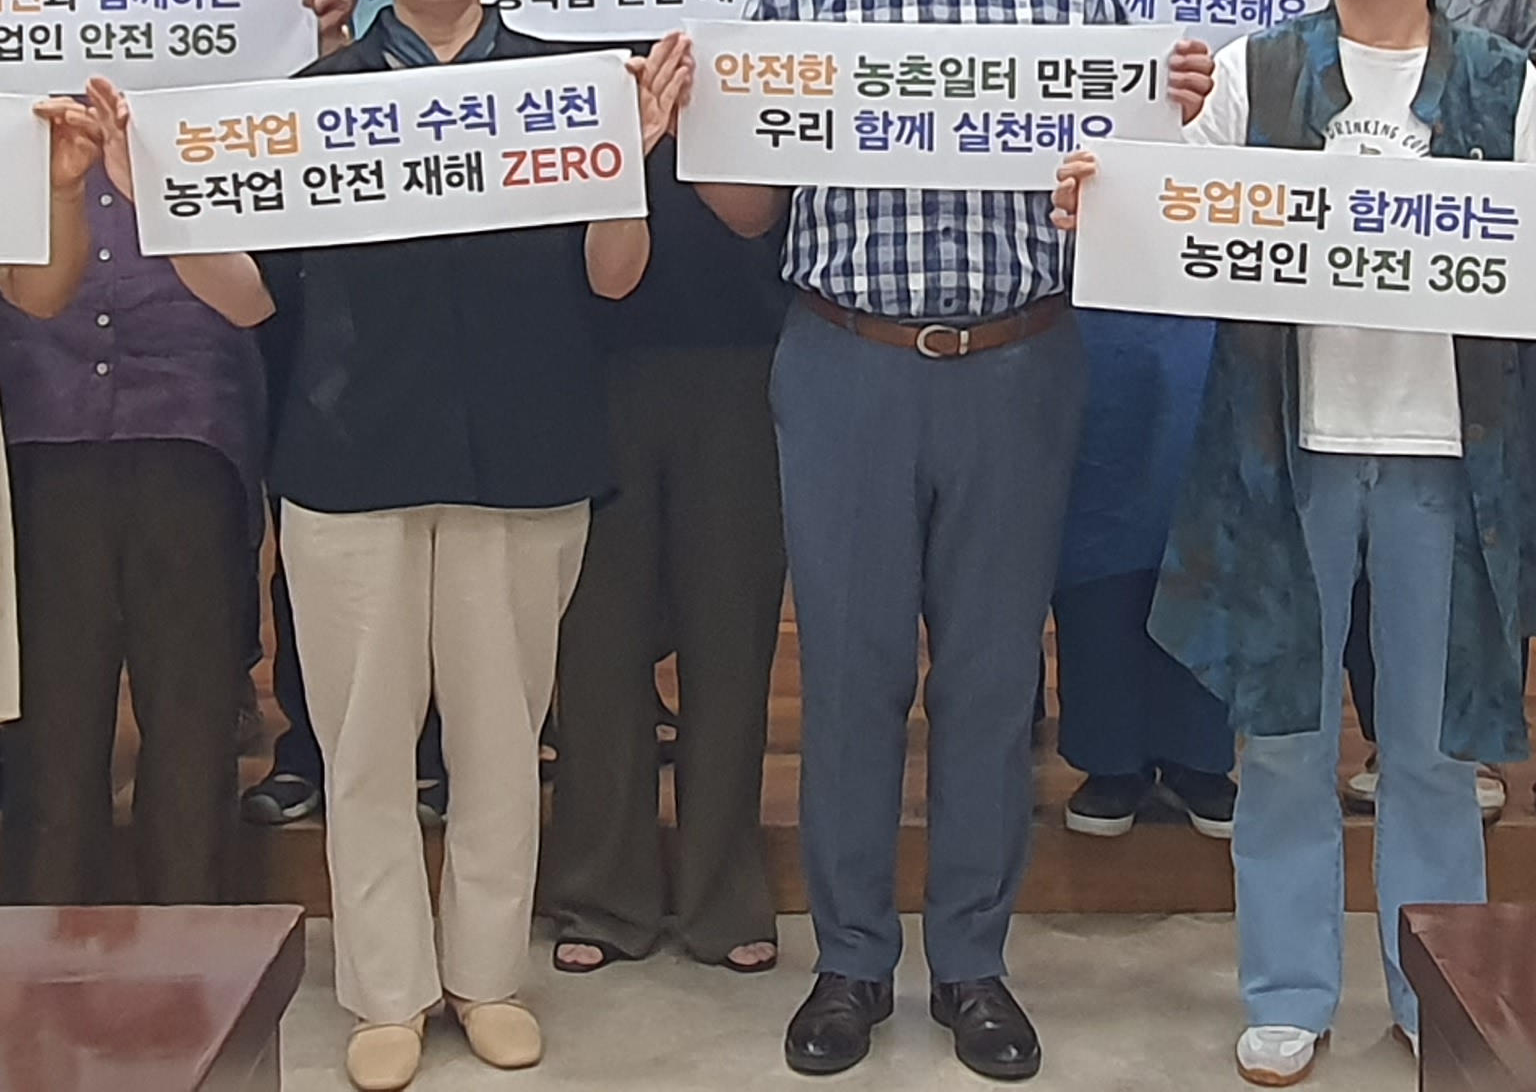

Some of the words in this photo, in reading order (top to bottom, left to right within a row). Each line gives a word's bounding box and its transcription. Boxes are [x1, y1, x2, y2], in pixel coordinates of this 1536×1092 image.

[80, 22, 154, 59] 안전
[168, 23, 237, 56] 365
[714, 53, 838, 97] 안전한
[853, 55, 1017, 100] 농촌일터
[1037, 58, 1158, 101] 만들기
[175, 112, 300, 163] 농작업
[316, 103, 401, 150] 안전
[416, 94, 497, 142] 수칙
[515, 84, 600, 132] 실천
[755, 108, 835, 150] 우리
[853, 110, 936, 152] 함께
[164, 168, 284, 217] 농작업
[302, 159, 386, 206] 안전
[402, 150, 485, 197] 재해
[501, 142, 622, 189] ZERO
[1159, 178, 1331, 230] 농업인과
[1349, 188, 1520, 241] 함께하는
[1180, 236, 1308, 285] 농업인
[1327, 245, 1411, 291] 안전
[1428, 254, 1507, 296] 365
